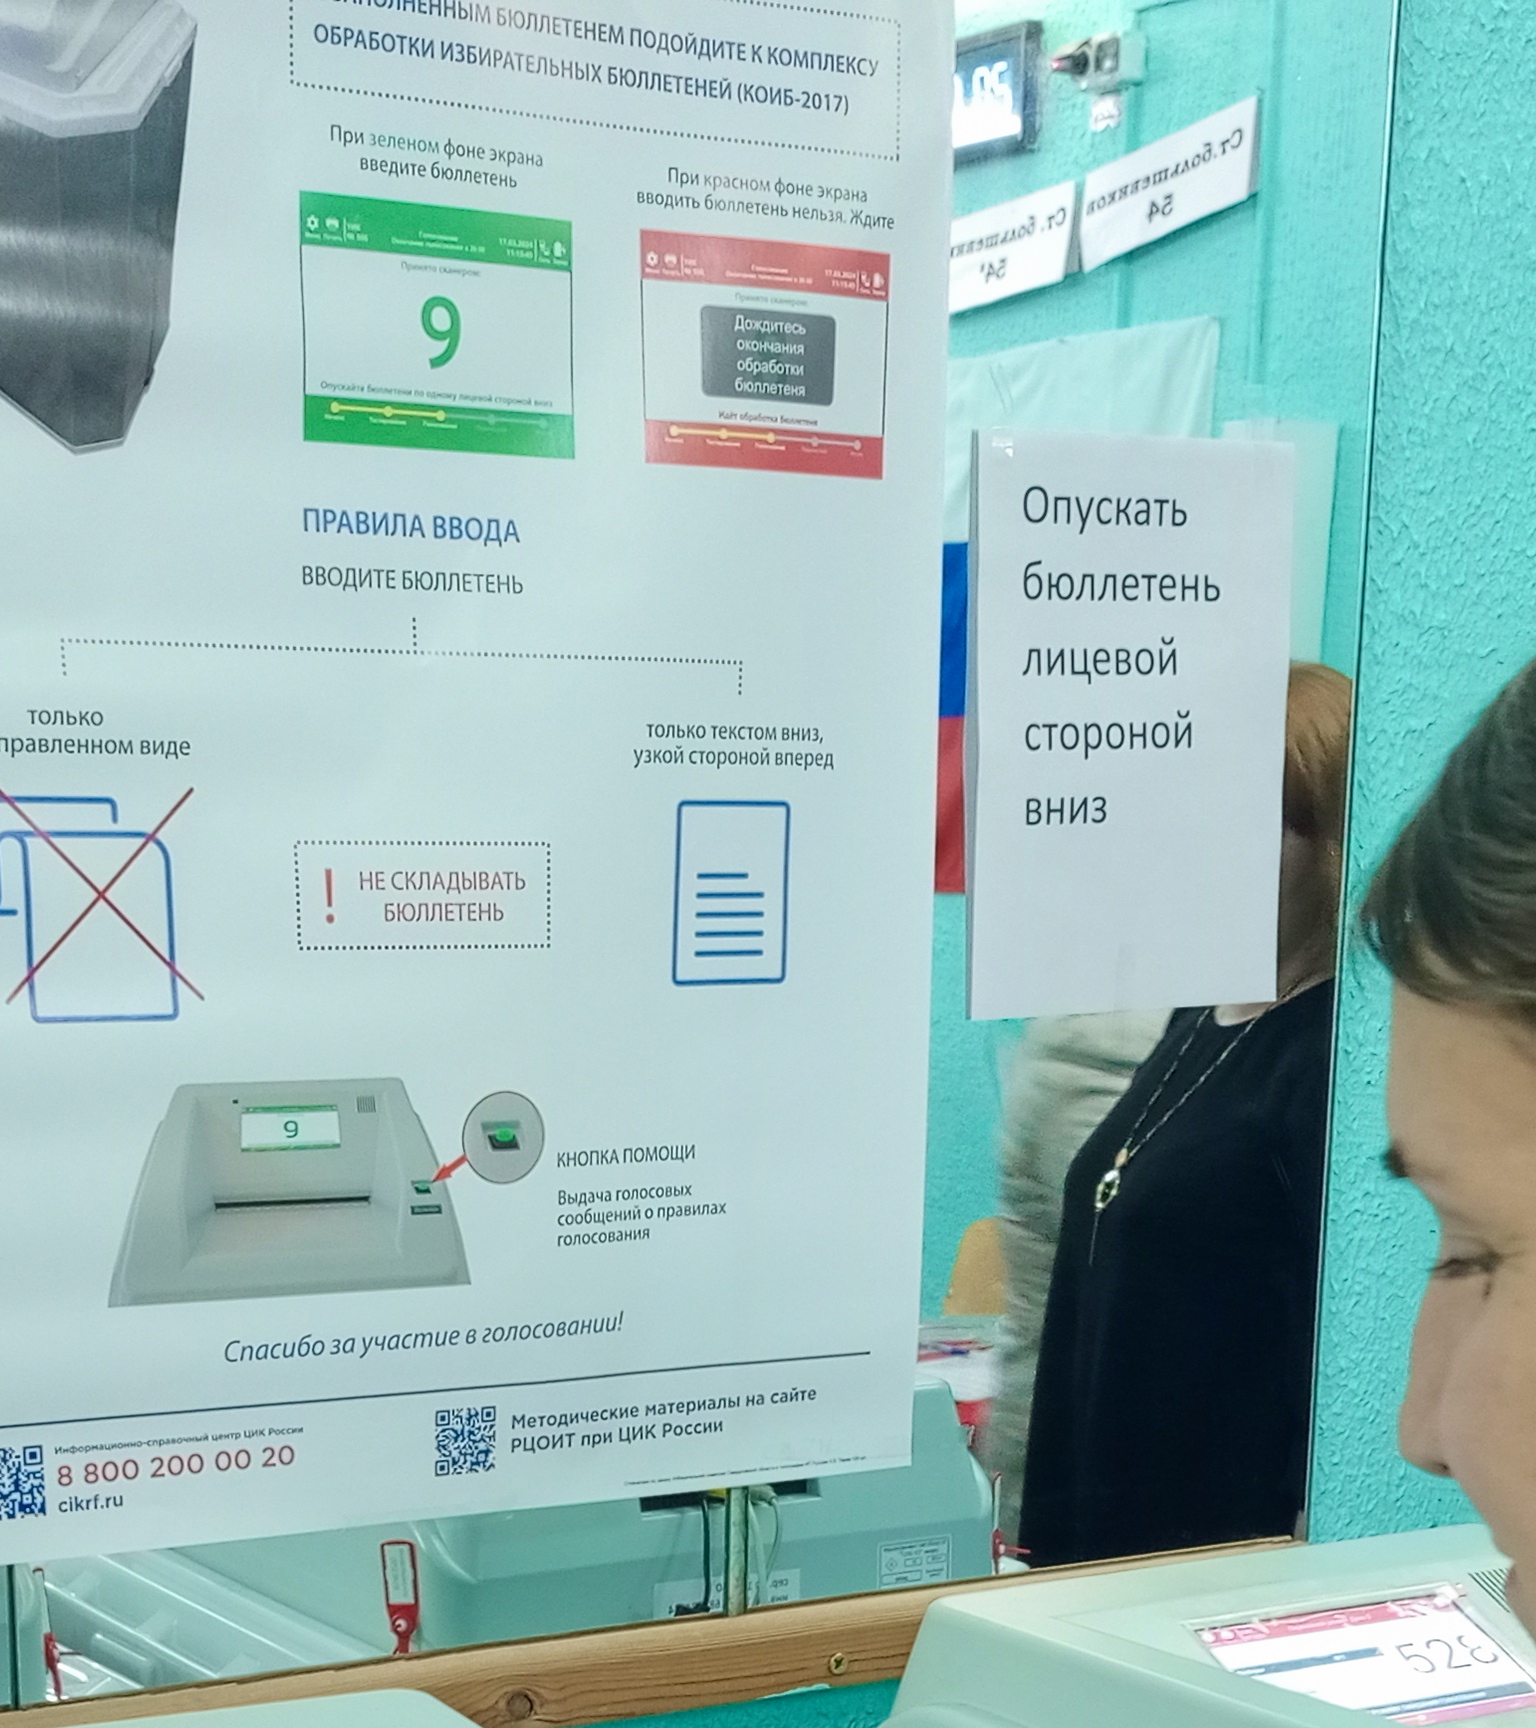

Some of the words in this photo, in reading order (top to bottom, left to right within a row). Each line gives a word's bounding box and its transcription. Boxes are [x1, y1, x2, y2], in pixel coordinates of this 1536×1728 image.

[496, 7, 625, 45] БЮЛЛЕТЕНЕМ
[629, 27, 747, 61] ПОДОЙДИТЕ
[751, 44, 763, 63] К
[766, 45, 879, 76] КОМПЛЕКСУ
[314, 23, 435, 59] ОБРАБОТКИ
[440, 40, 602, 83] ИЗБИРАТЕЛЬНЫХ
[607, 66, 732, 100] БЮЛЛЕТЕНЕЙ
[737, 82, 850, 116] (КОИБ-2017)
[329, 124, 365, 147] При
[369, 132, 439, 154] зеленом
[443, 139, 486, 161] фоне
[489, 147, 544, 167] экрана
[360, 156, 426, 178] введите
[430, 162, 518, 188] бюллетень
[667, 167, 700, 188] При
[703, 173, 771, 194] красном
[774, 178, 814, 197] фоне
[817, 184, 868, 205] экрана
[636, 191, 700, 211] вводить
[704, 194, 789, 218] бюллетень
[792, 205, 847, 224] нельзя.
[849, 209, 896, 230] Ждите
[421, 295, 462, 370] 9
[734, 314, 807, 336] Дождитесь
[736, 338, 805, 356] окончания
[736, 357, 804, 378] обработки
[734, 377, 806, 398] бюллетеня
[1022, 485, 1188, 535] Опускать
[302, 507, 426, 539] ПРАВИЛА
[432, 515, 521, 548] ВВОДА
[302, 565, 396, 592] ВВОДИТЕ
[402, 570, 524, 595] БЮЛЛЕТЕНЬ
[1022, 560, 1222, 603] бюллетень
[1022, 636, 1178, 684] лицевой
[26, 709, 105, 726] только
[646, 723, 707, 740] только
[710, 725, 777, 741] текстом
[781, 727, 824, 745] вниз,
[1024, 710, 1193, 760] стороной
[140, 739, 192, 760] виде
[633, 745, 684, 768] узкой
[688, 747, 770, 770] стороной
[775, 752, 835, 771] вперед
[1024, 796, 1108, 826] вниз
[359, 871, 386, 890] НЕ
[391, 871, 527, 894] СКЛАДЫВАТЬ
[384, 902, 505, 922] БЮЛЛЕТЕНЬ
[283, 1120, 299, 1139] 9
[556, 1147, 620, 1169] КНОПКА
[622, 1144, 696, 1167] ПОМОЩИ
[557, 1187, 612, 1209] Выдача
[615, 1182, 693, 1202] голосовых
[557, 1204, 642, 1227] сообщений
[643, 1209, 654, 1221] о
[657, 1202, 727, 1222] правилах
[557, 1227, 650, 1248] голосования
[224, 1334, 326, 1364] Спасибо
[330, 1338, 357, 1356] за
[360, 1327, 461, 1359] участие
[465, 1326, 478, 1346] в
[481, 1311, 625, 1347] голосовании!
[511, 1404, 640, 1430] Методические
[645, 1396, 741, 1419] материалы
[745, 1394, 765, 1407] на
[770, 1386, 817, 1404] сайте
[54, 1432, 209, 1456] Информационно-справочный
[211, 1431, 242, 1442] центр
[243, 1428, 266, 1440] ЦИК
[268, 1426, 304, 1438] России
[510, 1433, 577, 1454] РЦОИТ
[580, 1430, 613, 1448] при
[618, 1423, 657, 1444] ЦИК
[661, 1419, 724, 1439] России
[57, 1464, 74, 1488] 8
[83, 1458, 140, 1486] 800
[149, 1453, 206, 1479] 200
[214, 1448, 252, 1473] 00
[261, 1444, 296, 1469] 20
[57, 1492, 125, 1514] cikrf.ru
